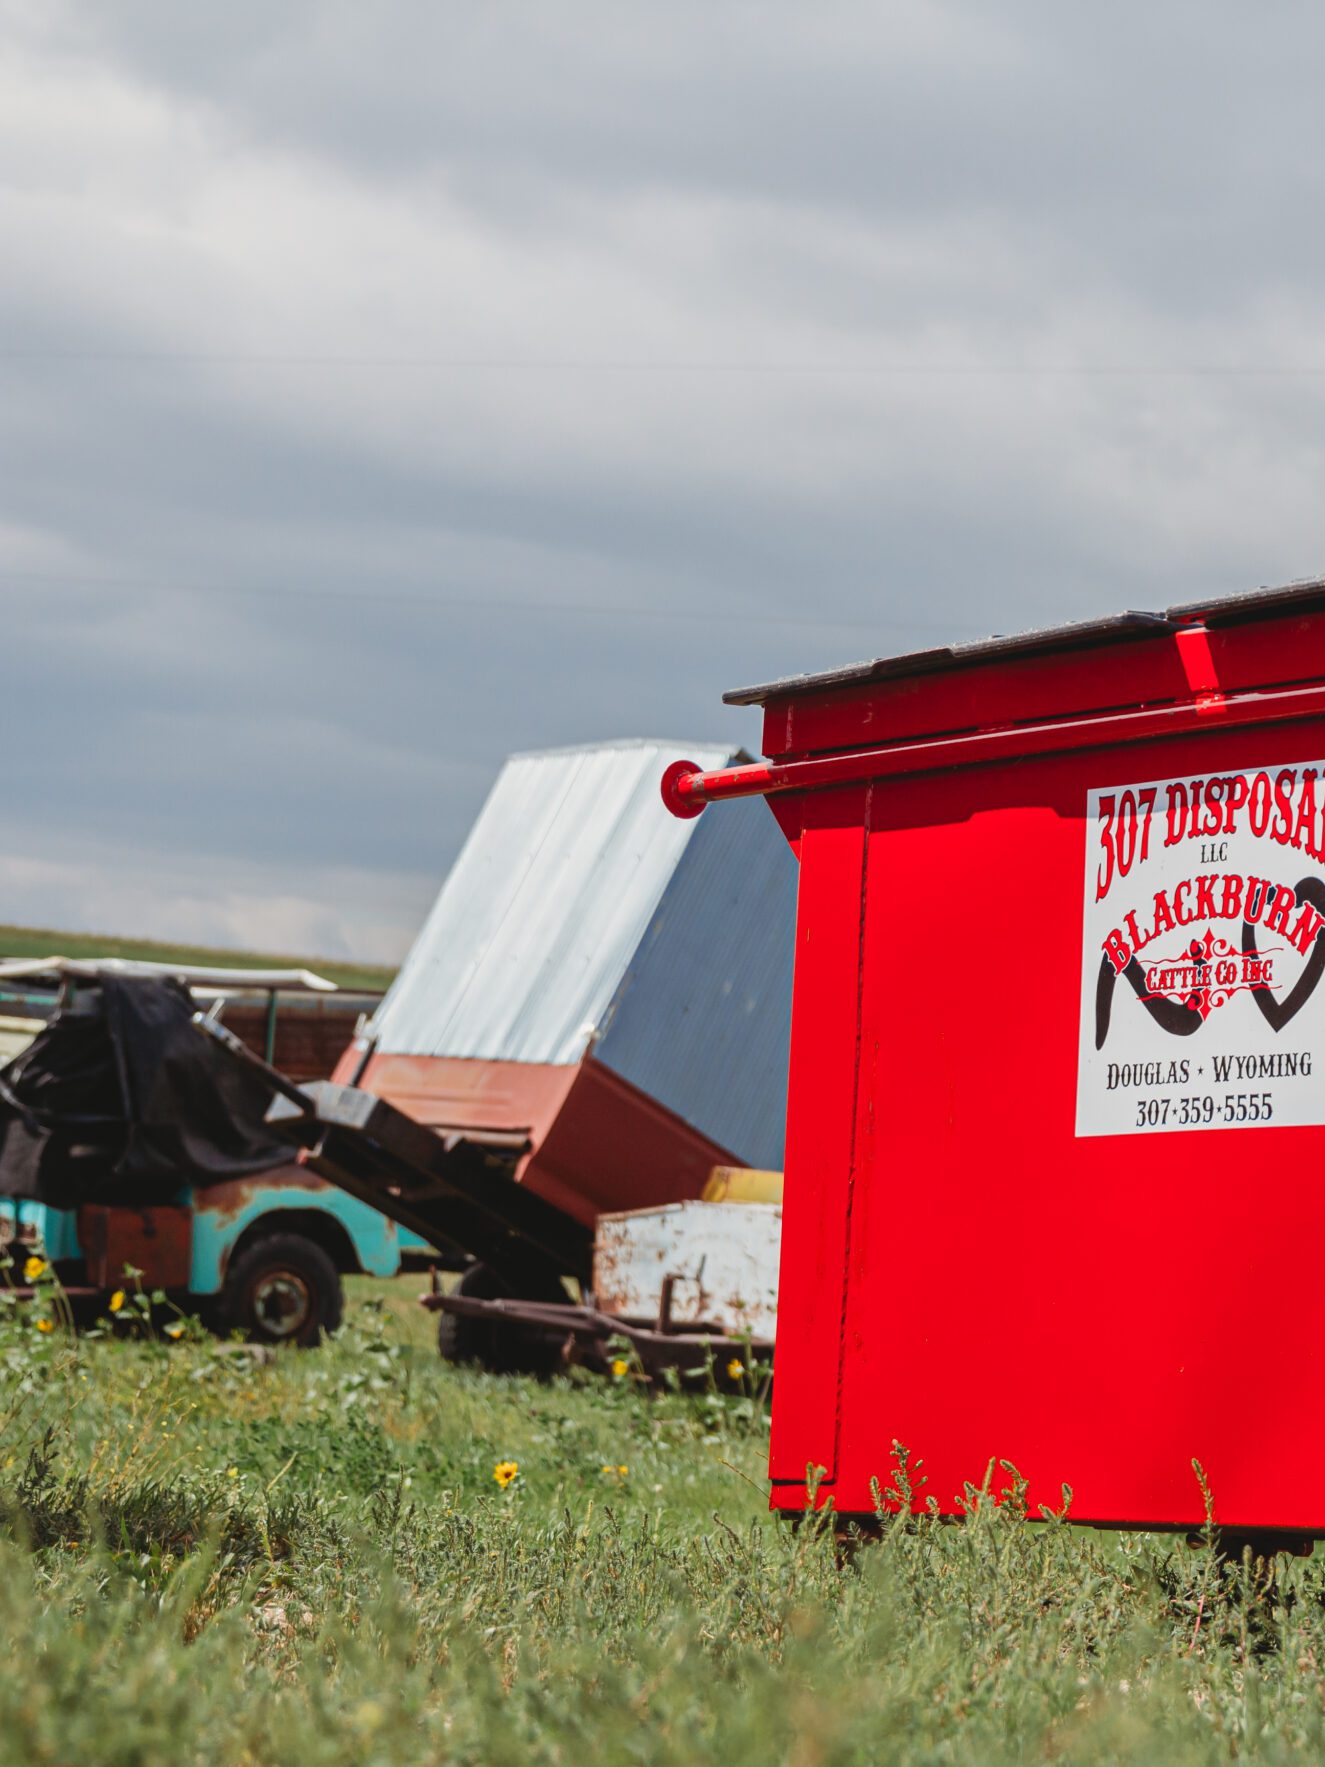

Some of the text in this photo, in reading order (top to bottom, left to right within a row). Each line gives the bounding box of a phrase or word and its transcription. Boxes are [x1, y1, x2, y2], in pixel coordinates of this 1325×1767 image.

[1096, 787, 1157, 903] 307
[1200, 842, 1228, 864] LLC
[1101, 874, 1325, 975] BLACKBURN
[1145, 958, 1273, 991] CATTLE CO INC
[1106, 1052, 1312, 1090] DOUGLAS WYOMING
